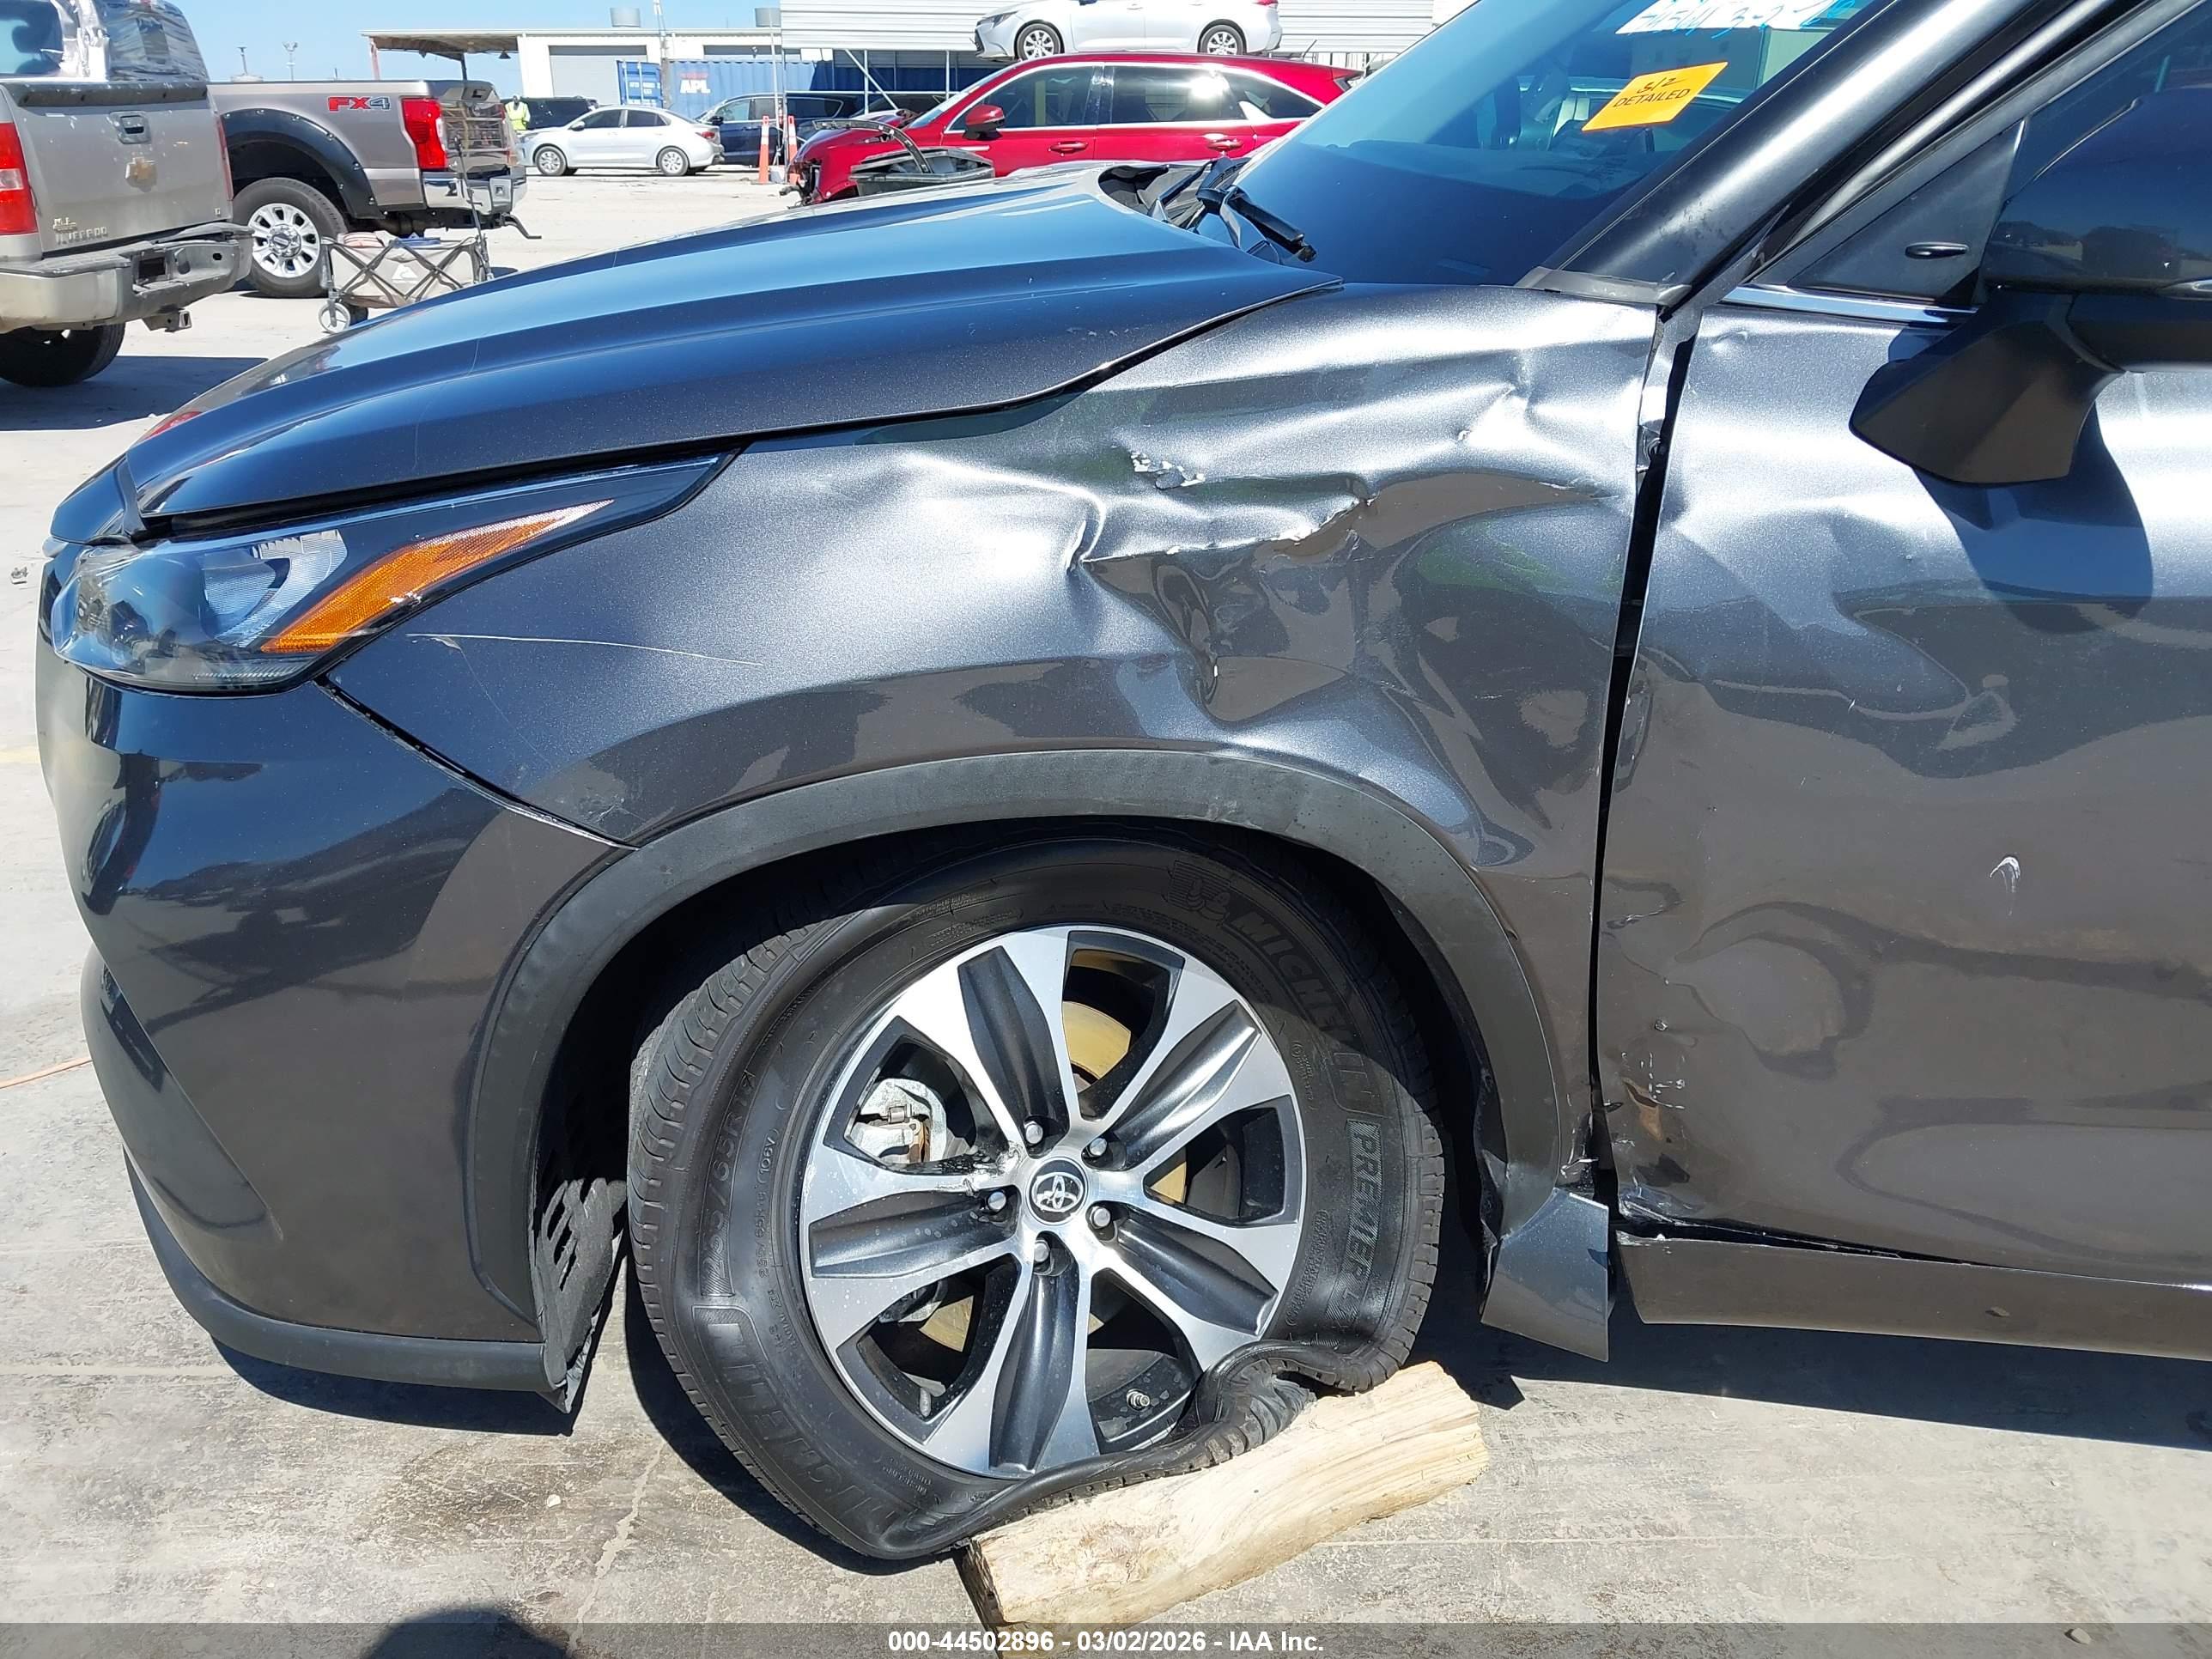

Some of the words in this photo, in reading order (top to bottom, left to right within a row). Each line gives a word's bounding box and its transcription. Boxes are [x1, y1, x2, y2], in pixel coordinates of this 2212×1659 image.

[679, 79, 711, 94] APL
[327, 96, 392, 112] FX4
[1613, 88, 1691, 107] DETAILED
[1345, 1131, 1381, 1281] PREMIER
